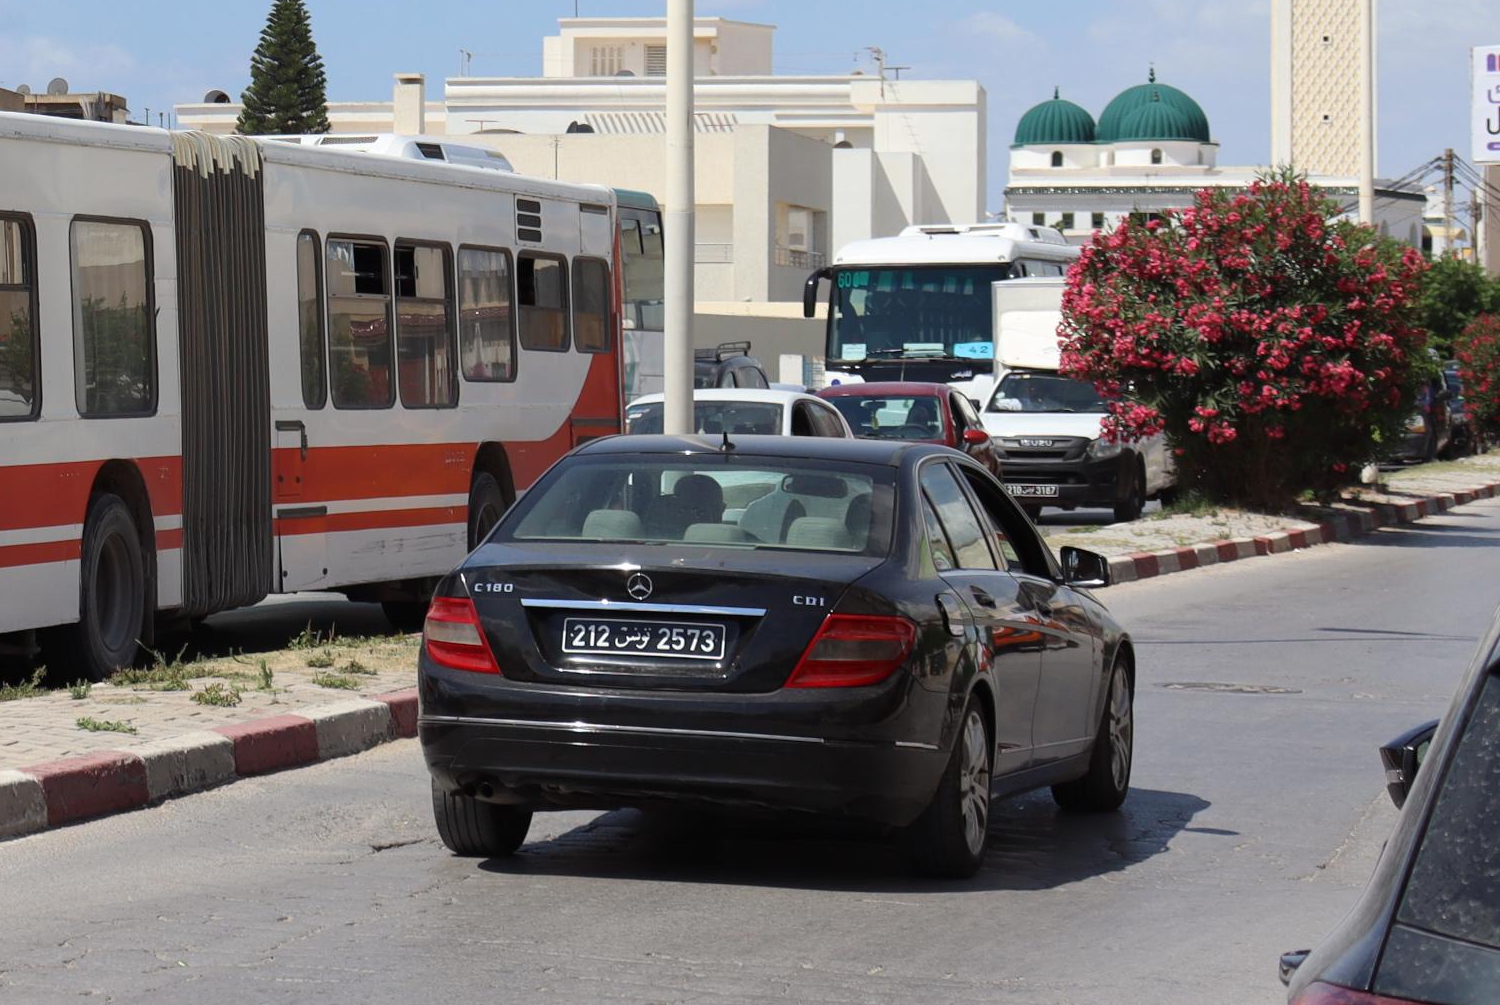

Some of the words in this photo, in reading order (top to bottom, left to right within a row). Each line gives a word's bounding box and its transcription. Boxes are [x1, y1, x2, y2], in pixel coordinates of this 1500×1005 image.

[1020, 439, 1053, 447] ISUZU
[792, 596, 825, 606] CDI
[572, 624, 610, 648] 212
[614, 626, 651, 649] تونس
[656, 628, 716, 653] 2573
